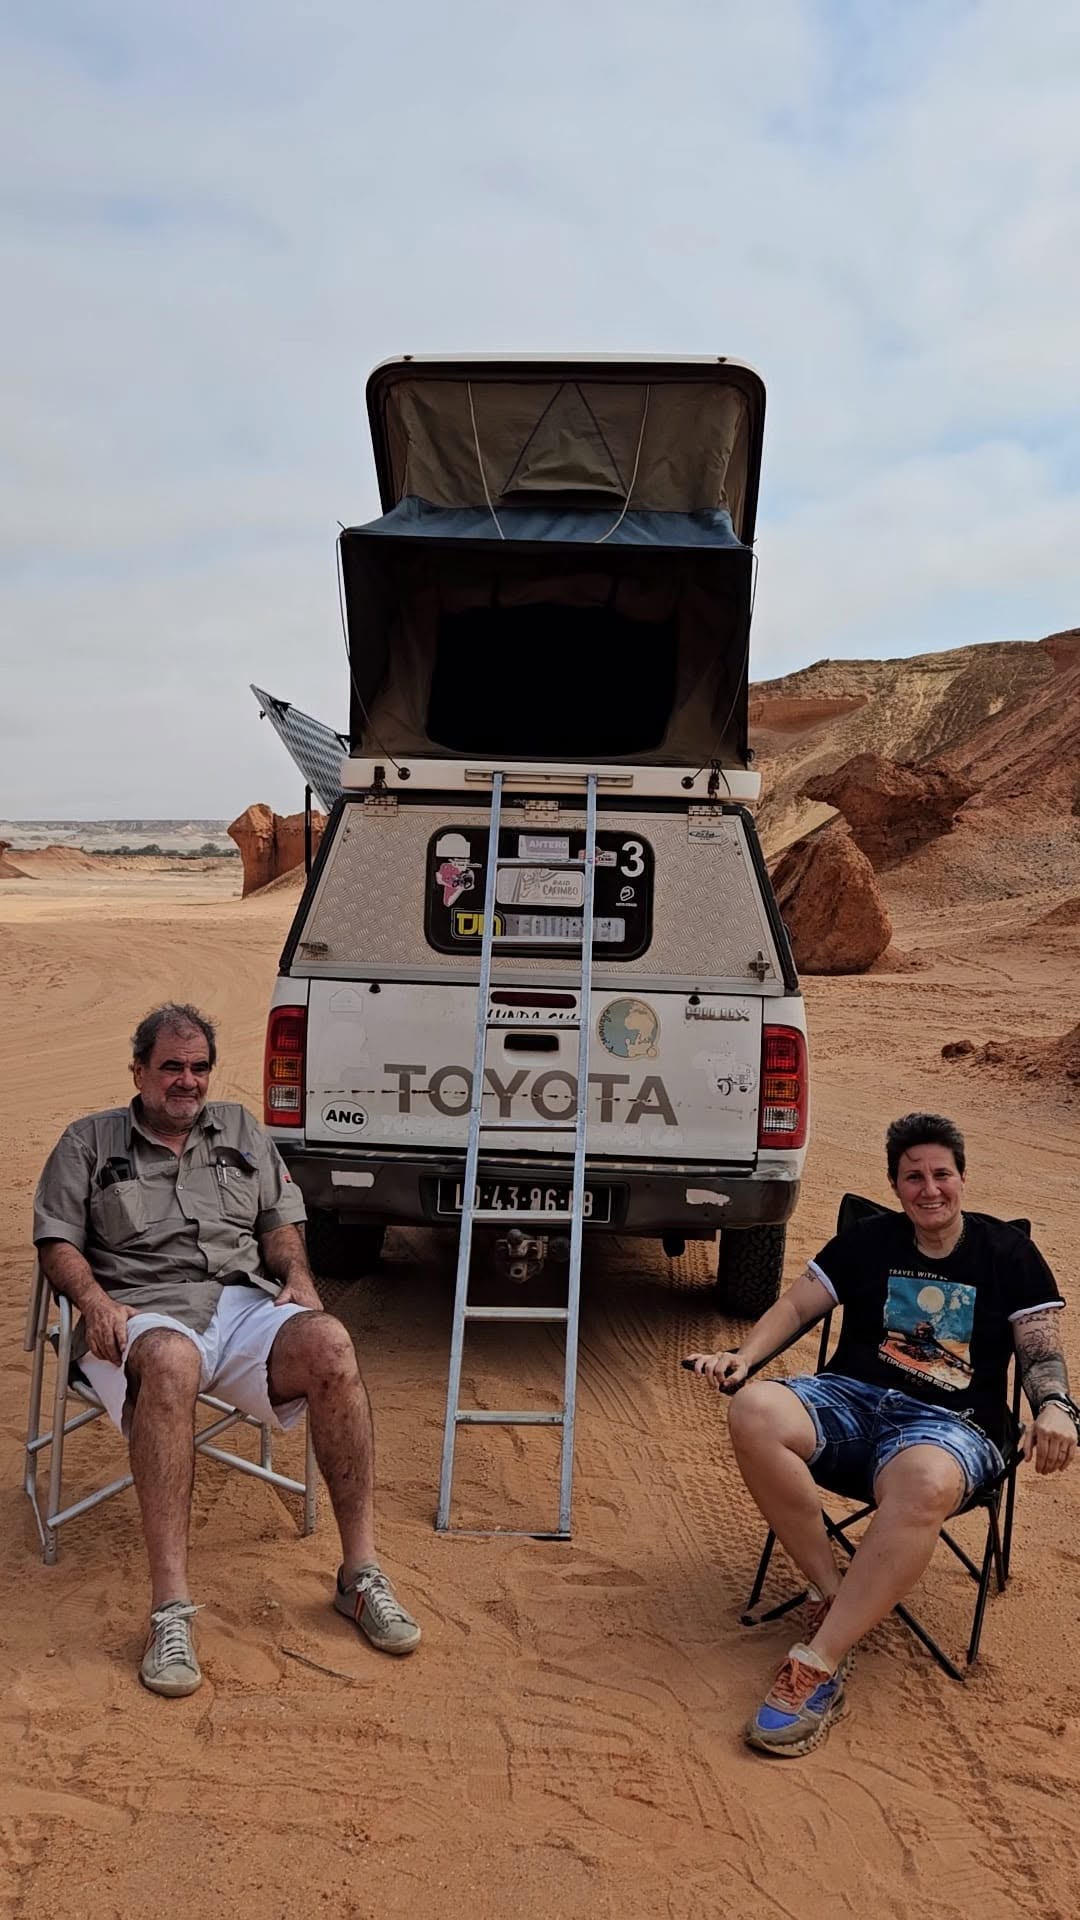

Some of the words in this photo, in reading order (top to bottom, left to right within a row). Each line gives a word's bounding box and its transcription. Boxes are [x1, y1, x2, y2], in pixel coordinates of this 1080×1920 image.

[529, 839, 568, 849] ANTERO
[620, 840, 645, 878] 3
[685, 1007, 750, 1022] HILUX
[384, 1063, 679, 1126] TOYOTA
[326, 1109, 365, 1126] ANG
[888, 1268, 915, 1278] TRAVEL
[917, 1270, 938, 1280] WITH
